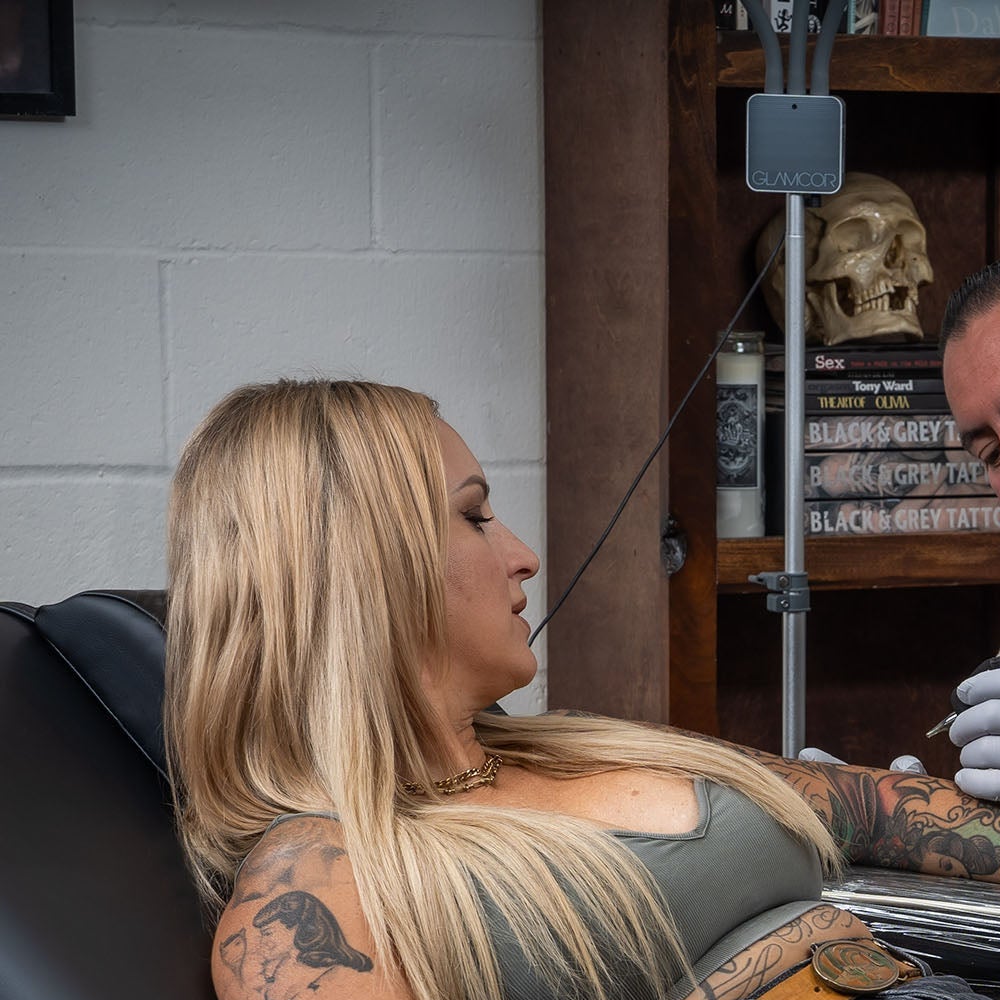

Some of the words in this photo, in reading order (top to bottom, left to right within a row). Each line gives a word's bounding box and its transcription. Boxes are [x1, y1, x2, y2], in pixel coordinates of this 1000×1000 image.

[752, 170, 837, 188] GLAMCOR
[815, 355, 846, 370] Sex
[852, 380, 881, 395] Tony
[882, 379, 914, 391] Ward
[809, 421, 872, 443] BLACK
[877, 420, 891, 443] &
[893, 420, 940, 442] GREY
[810, 465, 873, 487] BLACK
[894, 462, 942, 485] GREY
[810, 509, 874, 533] BLACK
[879, 508, 893, 532] &
[894, 507, 942, 531] GREY
